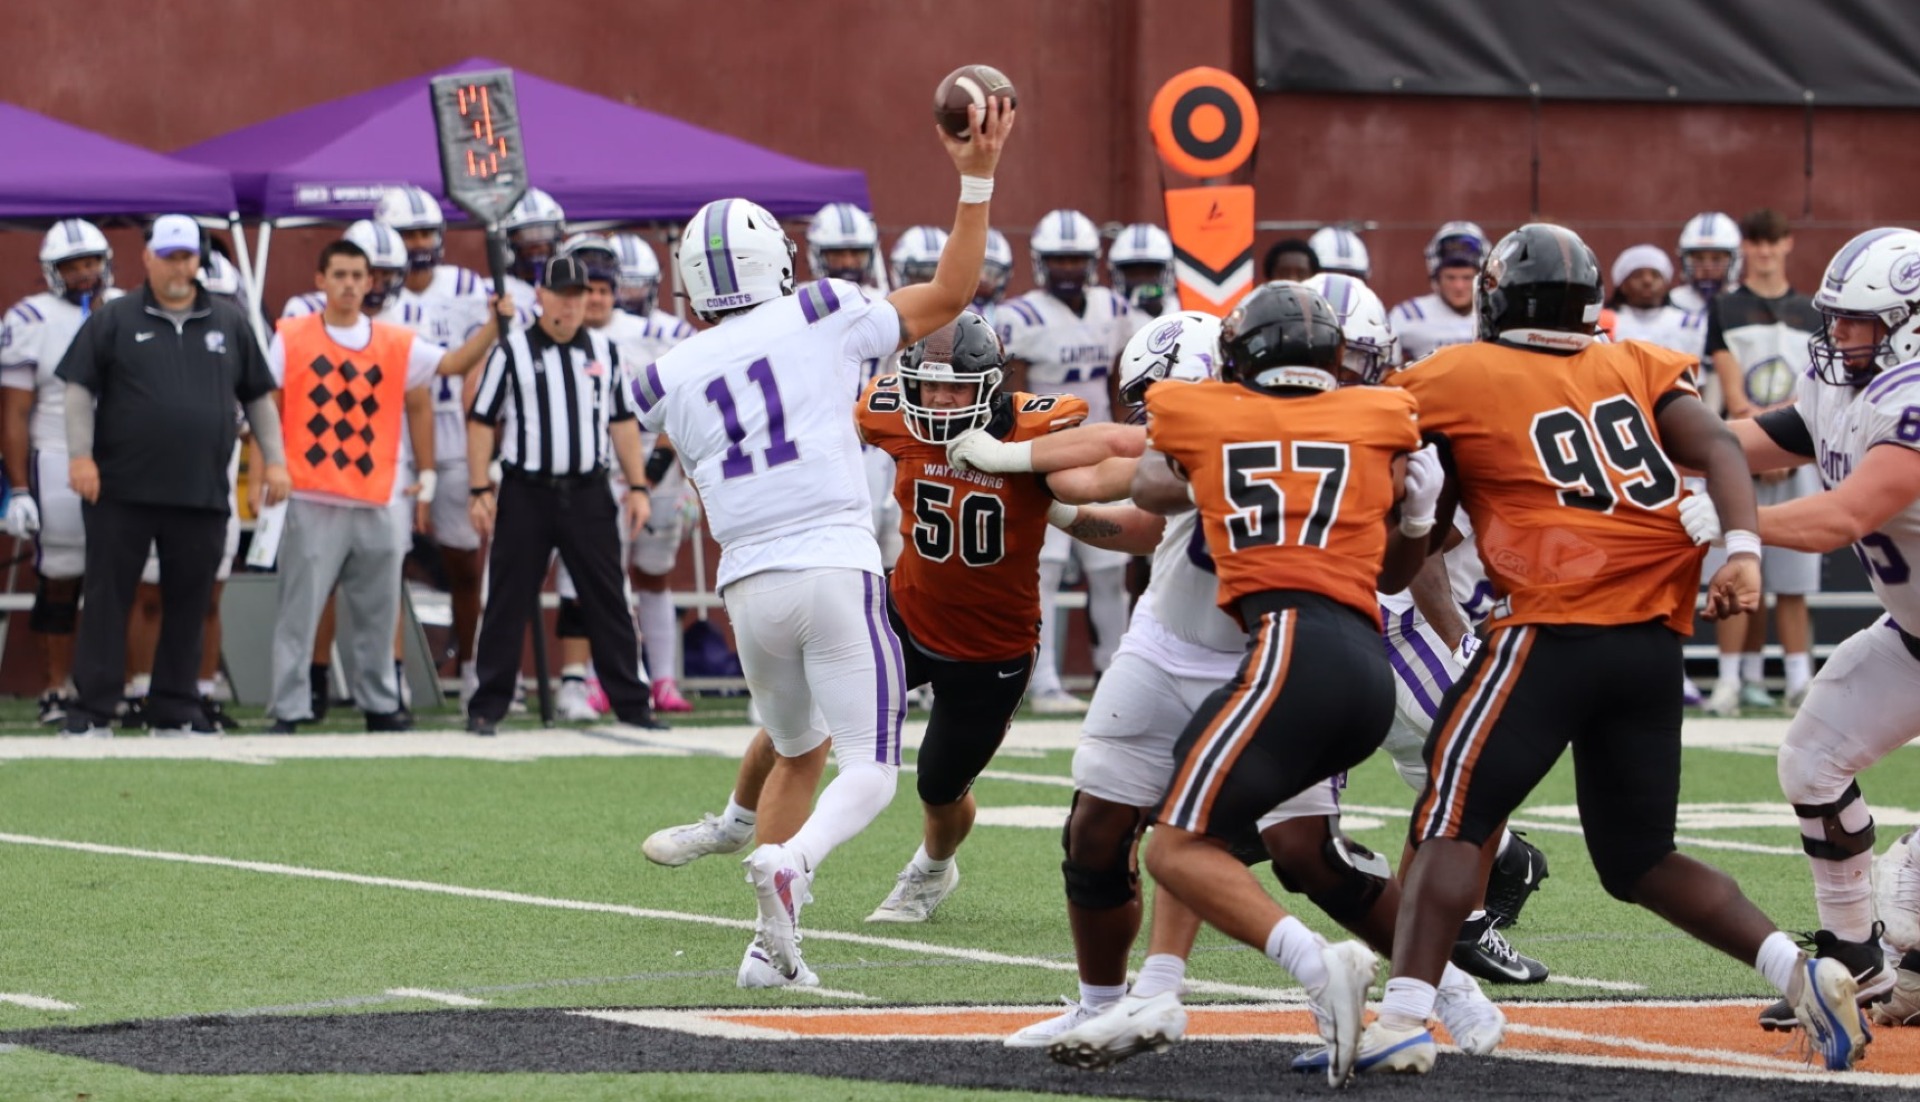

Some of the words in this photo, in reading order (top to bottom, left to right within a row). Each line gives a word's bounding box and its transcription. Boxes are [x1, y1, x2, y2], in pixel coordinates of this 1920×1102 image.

[706, 293, 752, 308] COMETS
[704, 355, 800, 481] 11
[1529, 393, 1681, 515] 99
[912, 478, 1005, 568] 50
[923, 463, 1004, 489] WAYNESBURG
[1222, 440, 1350, 553] 57
